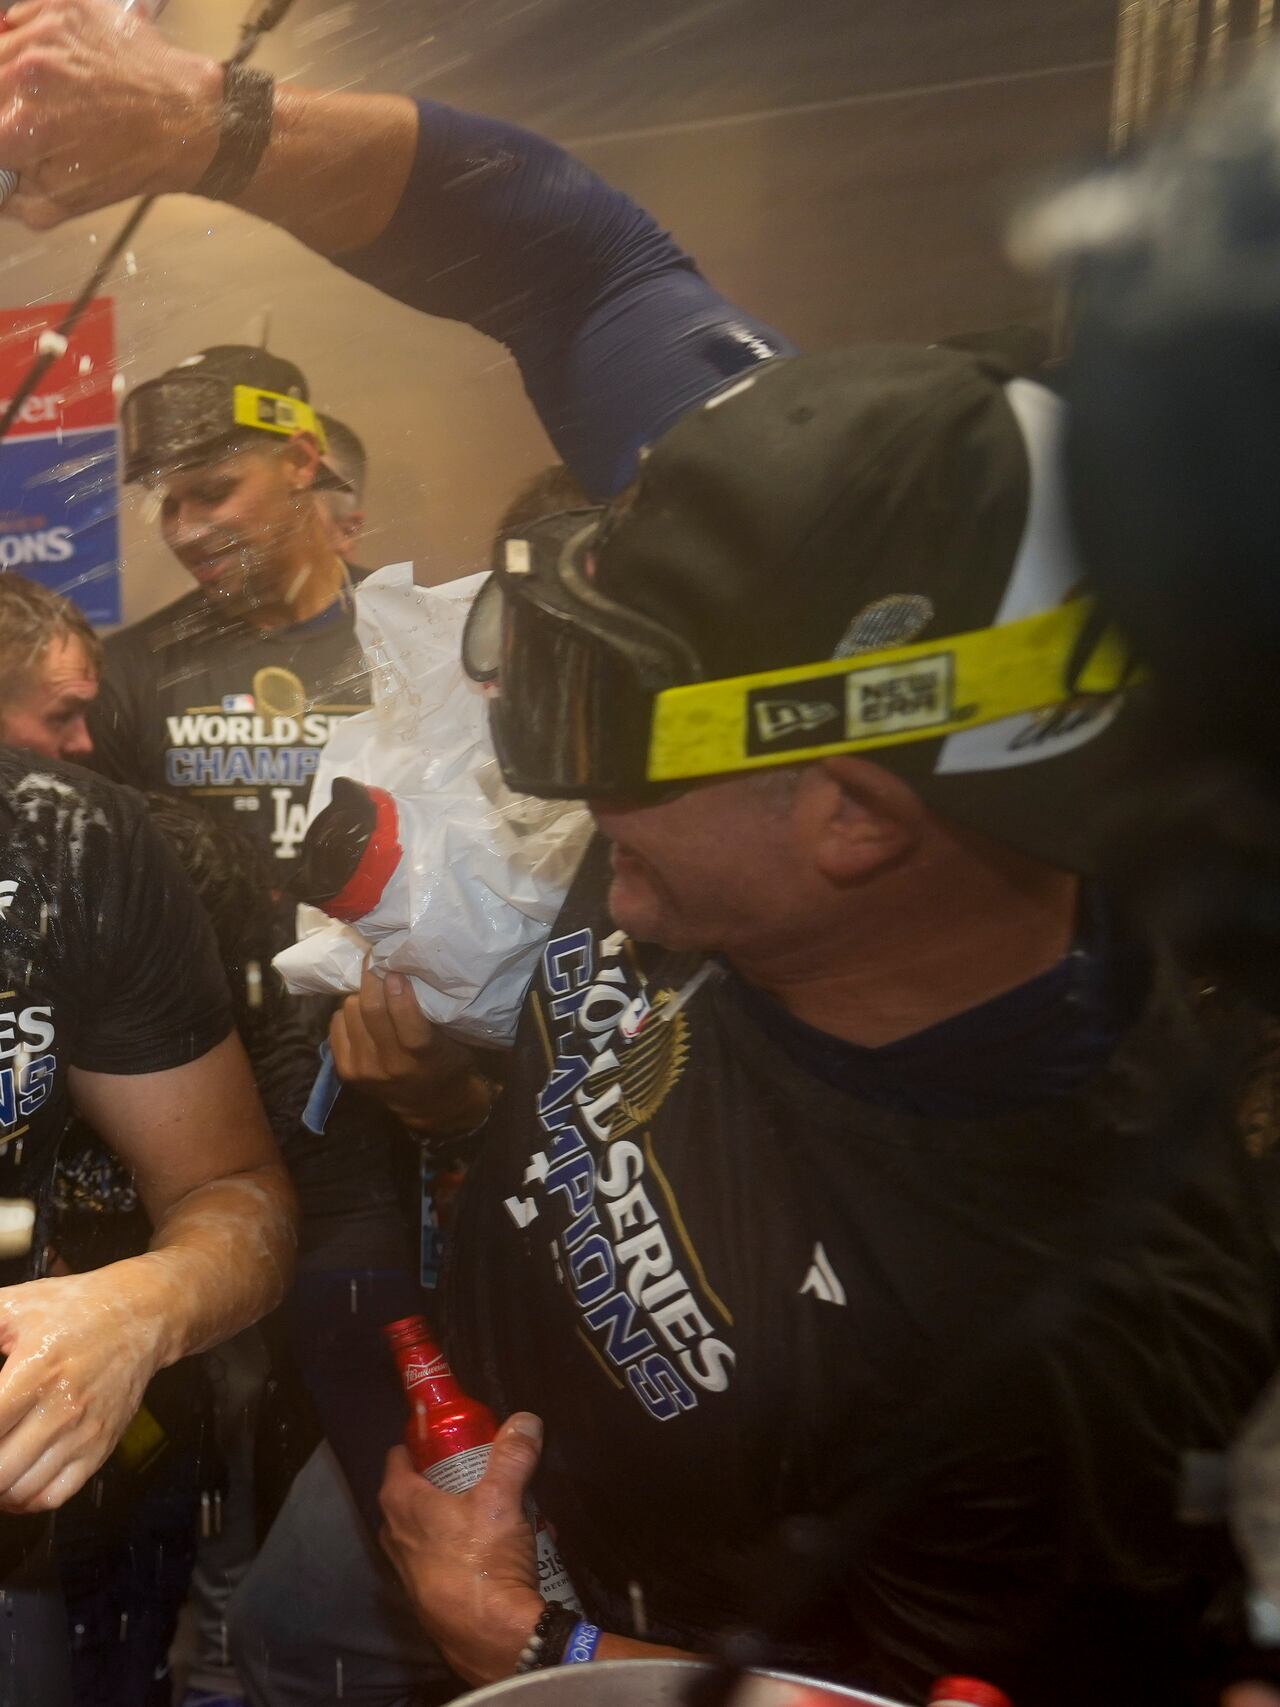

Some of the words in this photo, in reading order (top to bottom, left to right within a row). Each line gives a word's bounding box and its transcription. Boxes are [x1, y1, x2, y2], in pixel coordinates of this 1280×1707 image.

[166, 714, 300, 746] WORLD
[166, 747, 322, 786] CHAMP
[597, 1140, 737, 1393] SERIES
